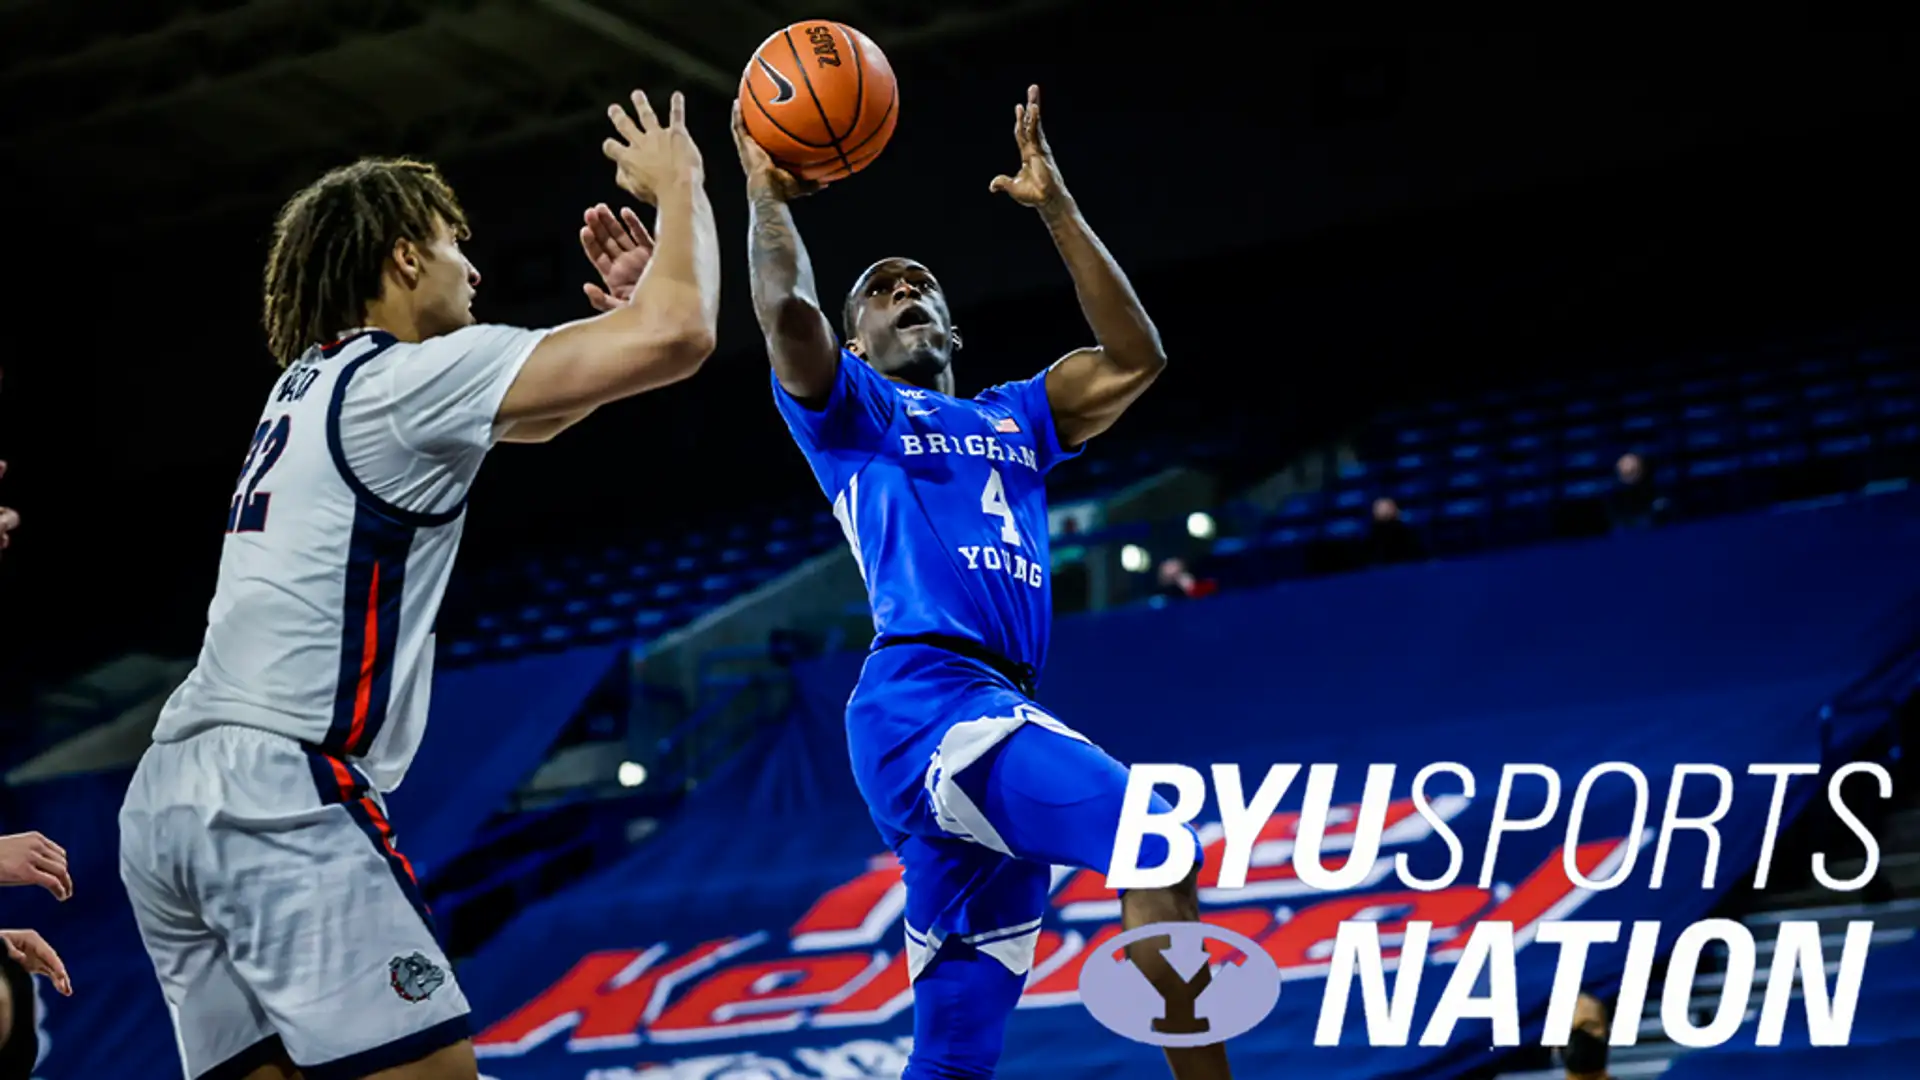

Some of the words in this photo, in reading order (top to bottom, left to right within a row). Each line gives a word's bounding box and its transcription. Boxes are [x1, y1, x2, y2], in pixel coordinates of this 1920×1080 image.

[805, 26, 841, 68] ZAGS
[226, 414, 291, 533] 22
[901, 433, 1038, 472] BRIGHAM
[981, 467, 1020, 546] 4
[958, 546, 1042, 588] YOUNG
